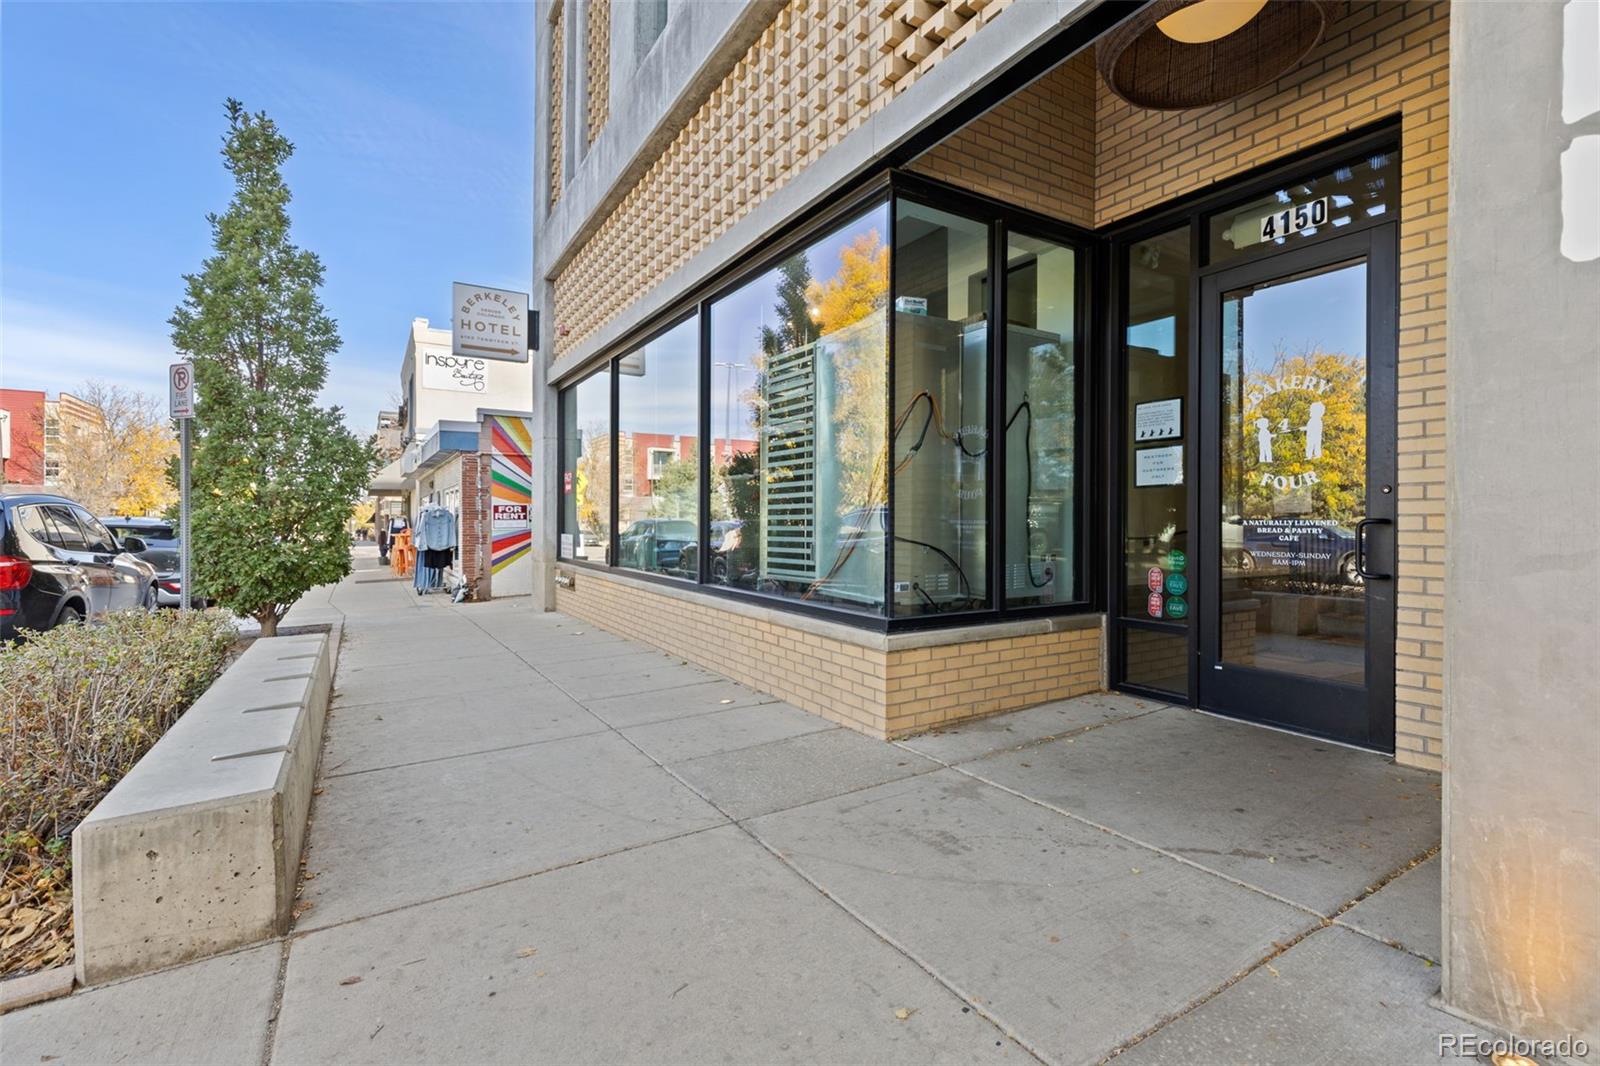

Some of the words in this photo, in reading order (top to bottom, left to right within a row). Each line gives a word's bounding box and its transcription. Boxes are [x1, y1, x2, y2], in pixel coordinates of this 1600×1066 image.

[1263, 200, 1325, 238] 4150
[461, 292, 521, 322] BERKELEY
[460, 319, 521, 337] HOTEL
[425, 352, 485, 371] Inspyre
[174, 400, 188, 408] LANE
[1260, 471, 1320, 489] FOUR
[495, 512, 526, 520] RENT
